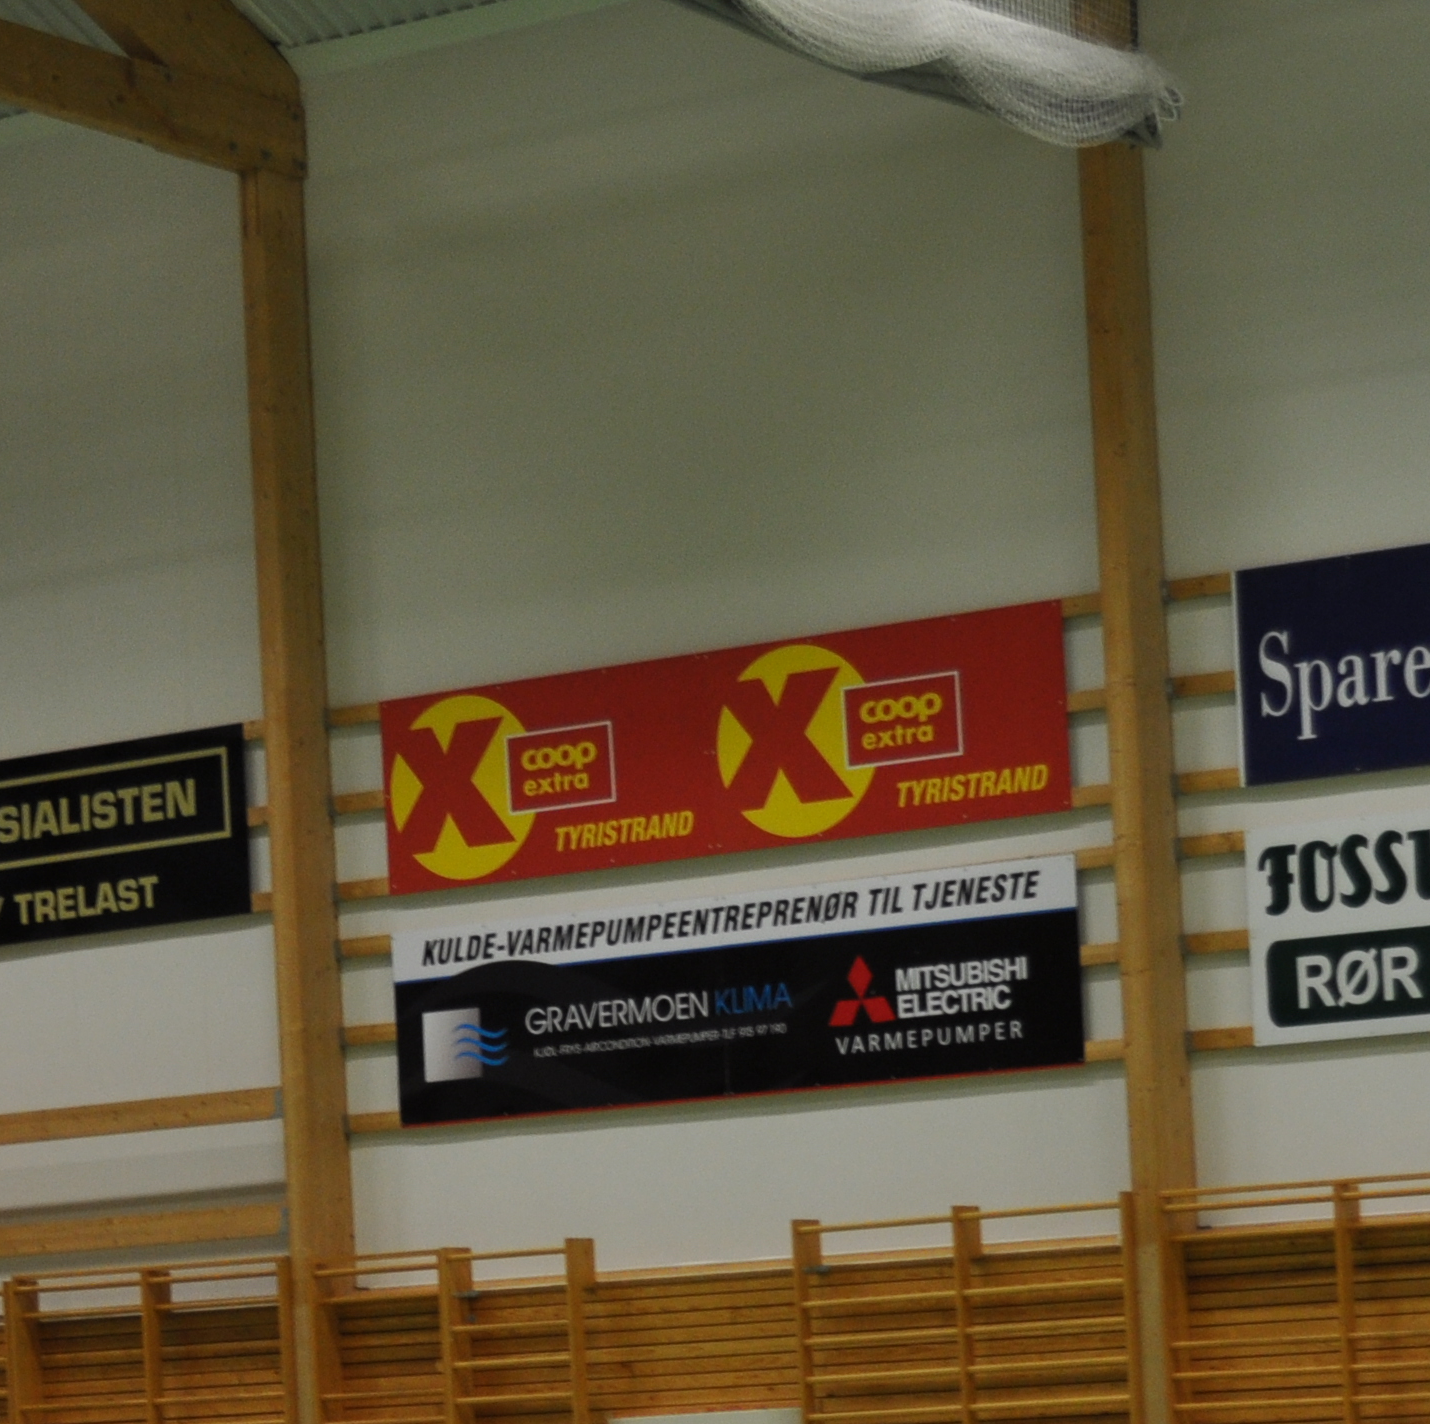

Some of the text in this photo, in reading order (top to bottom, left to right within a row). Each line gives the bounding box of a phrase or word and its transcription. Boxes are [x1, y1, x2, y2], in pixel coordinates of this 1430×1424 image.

[860, 692, 942, 724] coop
[862, 721, 934, 751] extra
[521, 741, 597, 771] coop
[523, 769, 590, 797] extra
[897, 764, 1048, 807] TYRISTRAND
[555, 811, 694, 852] TYRISTRAND
[14, 875, 159, 925] TRELAST
[868, 887, 904, 917] TIL
[911, 870, 1041, 914] TJENESTE
[895, 955, 1029, 993] MITSUBISHI
[1295, 947, 1422, 1010] RØR
[525, 983, 792, 1037] GRAVERMOEN KLIMA
[896, 985, 1011, 1019] ELECTRIC
[835, 1020, 1025, 1056] VARMEPUMPER
